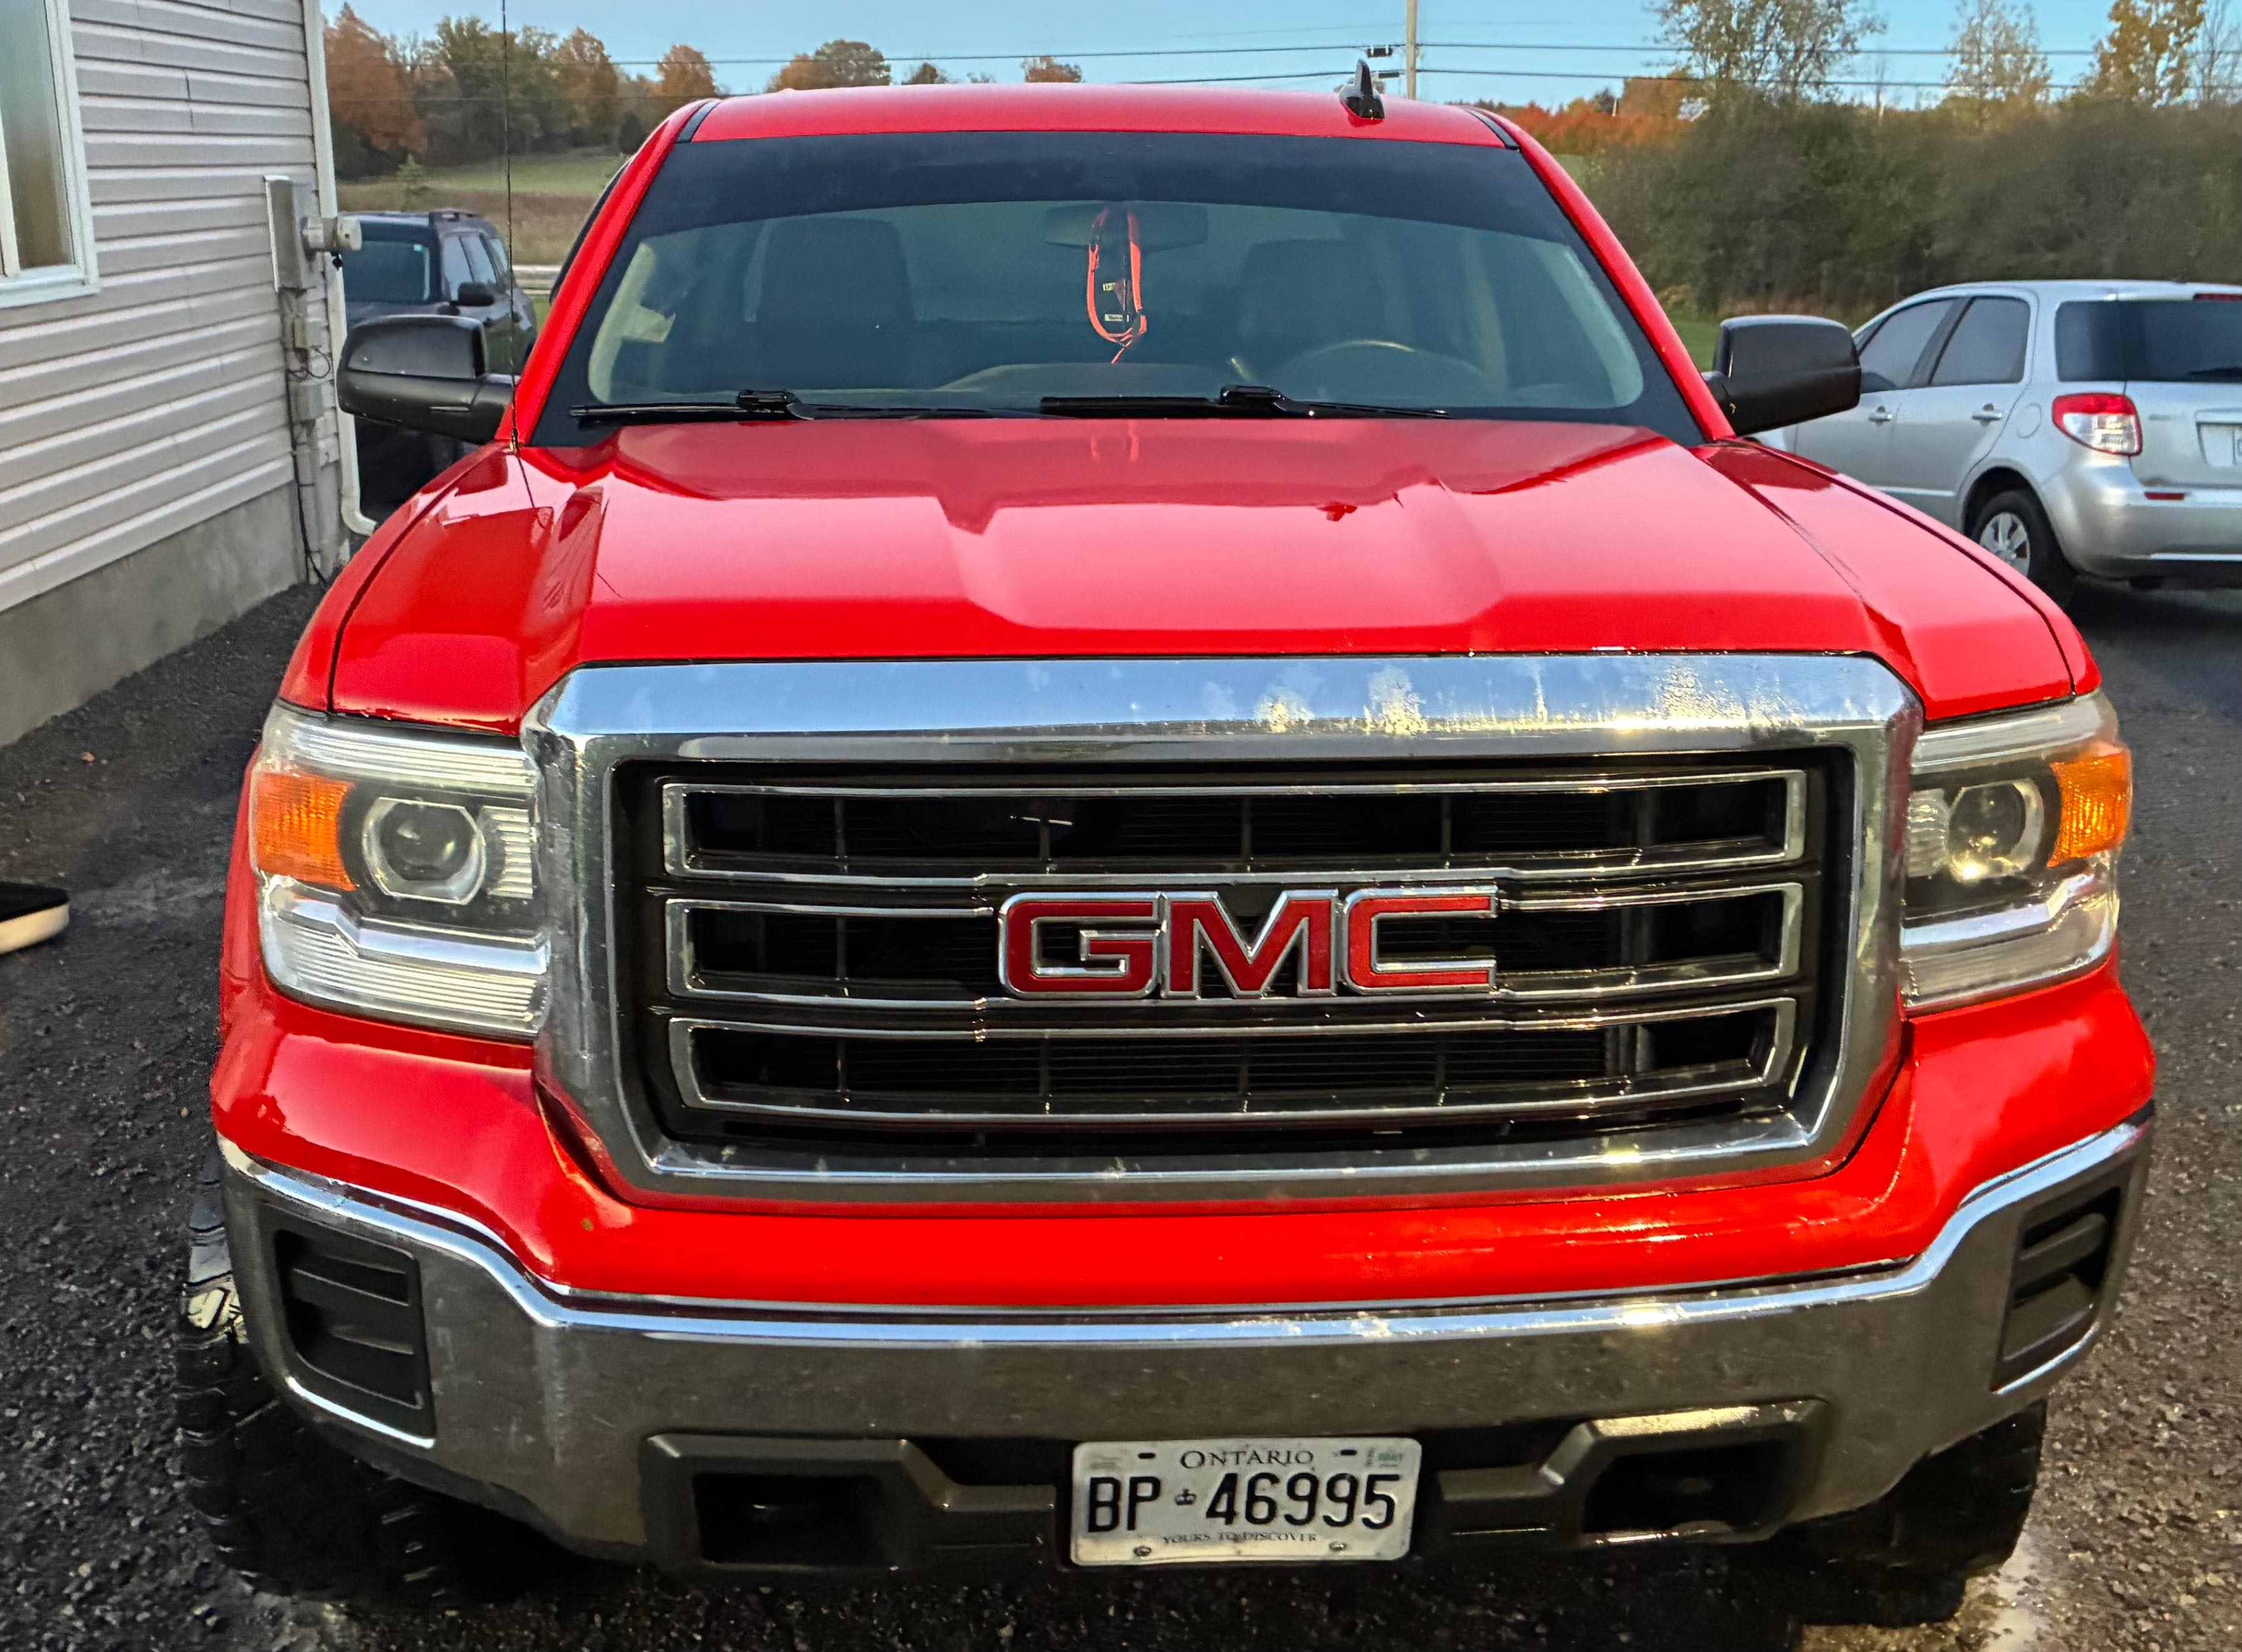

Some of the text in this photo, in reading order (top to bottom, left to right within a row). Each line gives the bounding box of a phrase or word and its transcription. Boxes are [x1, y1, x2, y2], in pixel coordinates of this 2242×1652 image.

[999, 887, 1498, 999] GMC
[1180, 1449, 1315, 1468] ONTARIO
[1088, 1471, 1401, 1533] BP 46995
[1163, 1532, 1317, 1545] YOURS TO DISCOVER
